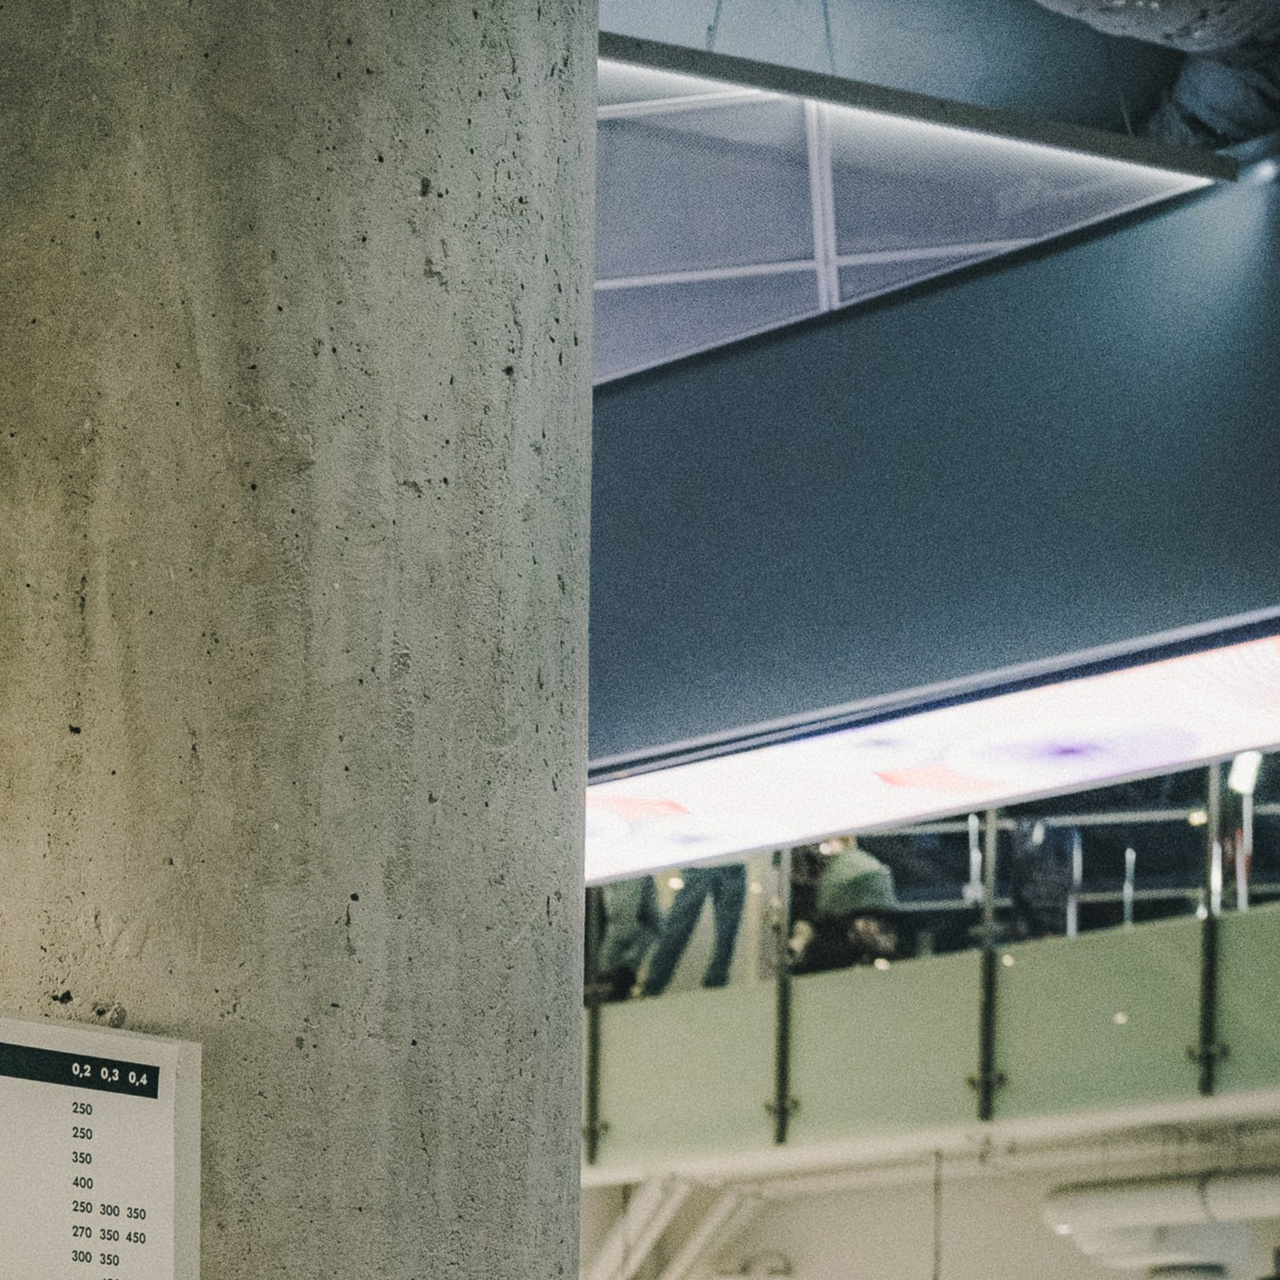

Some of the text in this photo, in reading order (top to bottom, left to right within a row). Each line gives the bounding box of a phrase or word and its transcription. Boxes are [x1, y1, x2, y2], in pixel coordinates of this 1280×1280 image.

[71, 1062, 92, 1078] 0,2
[100, 1067, 120, 1082] 0,3
[127, 1071, 148, 1087] 0,4
[71, 1101, 94, 1116] 250
[71, 1125, 94, 1141] 250
[71, 1199, 94, 1214] 250
[99, 1203, 121, 1218] 300
[126, 1206, 147, 1221] 350
[71, 1224, 93, 1239] 270
[99, 1227, 120, 1242] 350
[125, 1231, 147, 1245] 450
[71, 1249, 93, 1264] 300
[99, 1252, 120, 1267] 350
